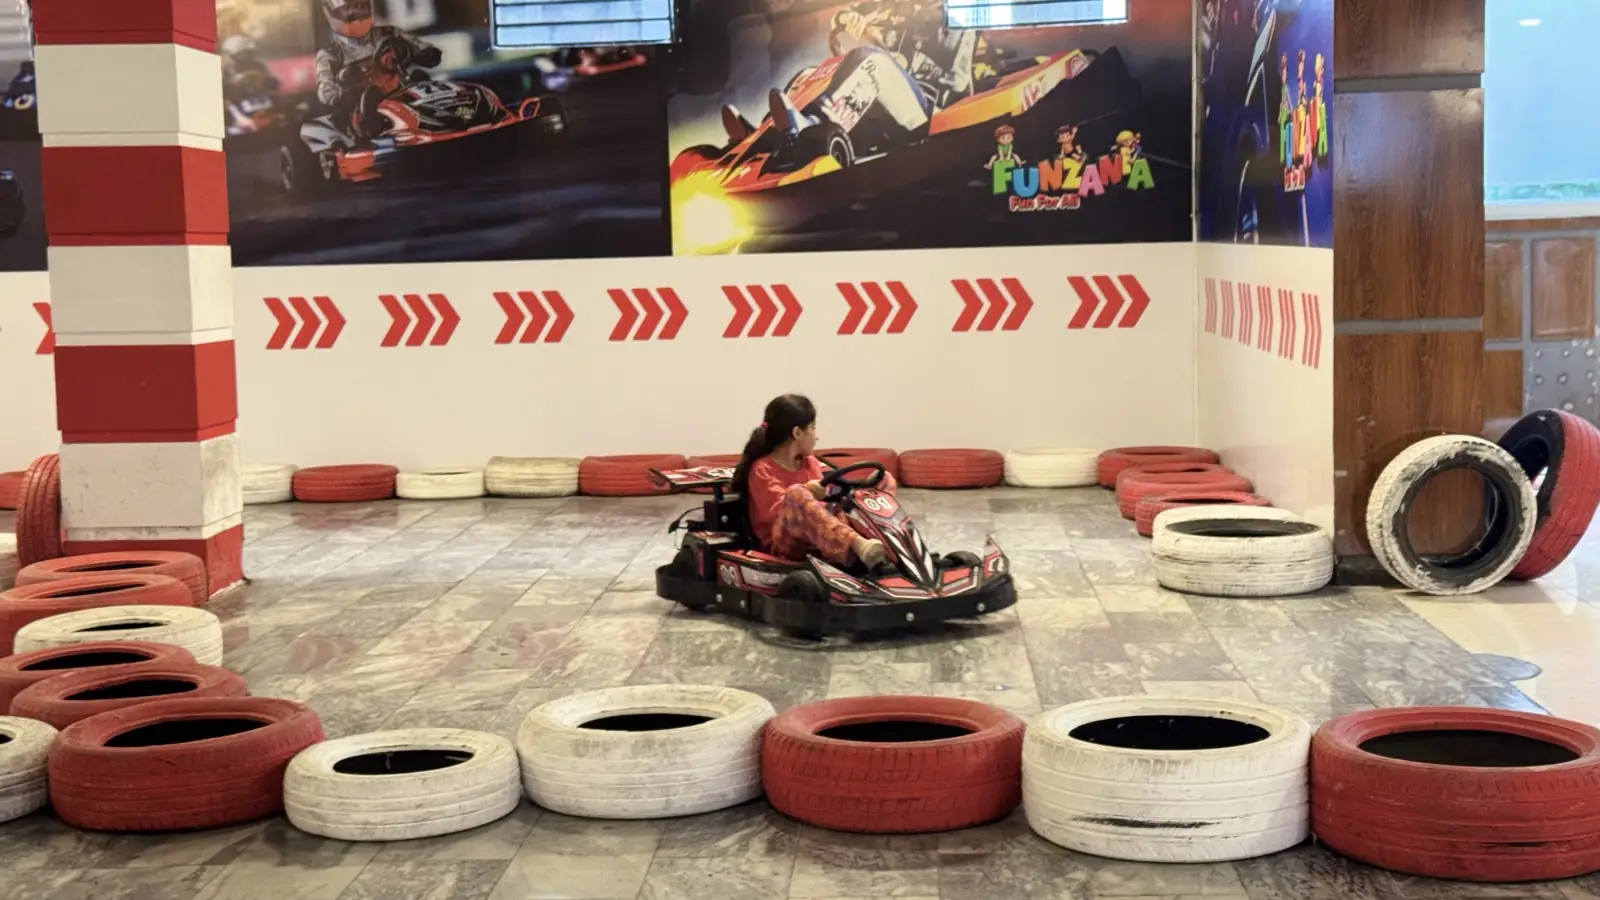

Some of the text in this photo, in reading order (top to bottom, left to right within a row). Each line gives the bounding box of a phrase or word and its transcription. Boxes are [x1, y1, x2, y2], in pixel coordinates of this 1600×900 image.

[1009, 194, 1080, 212] Fun For All
